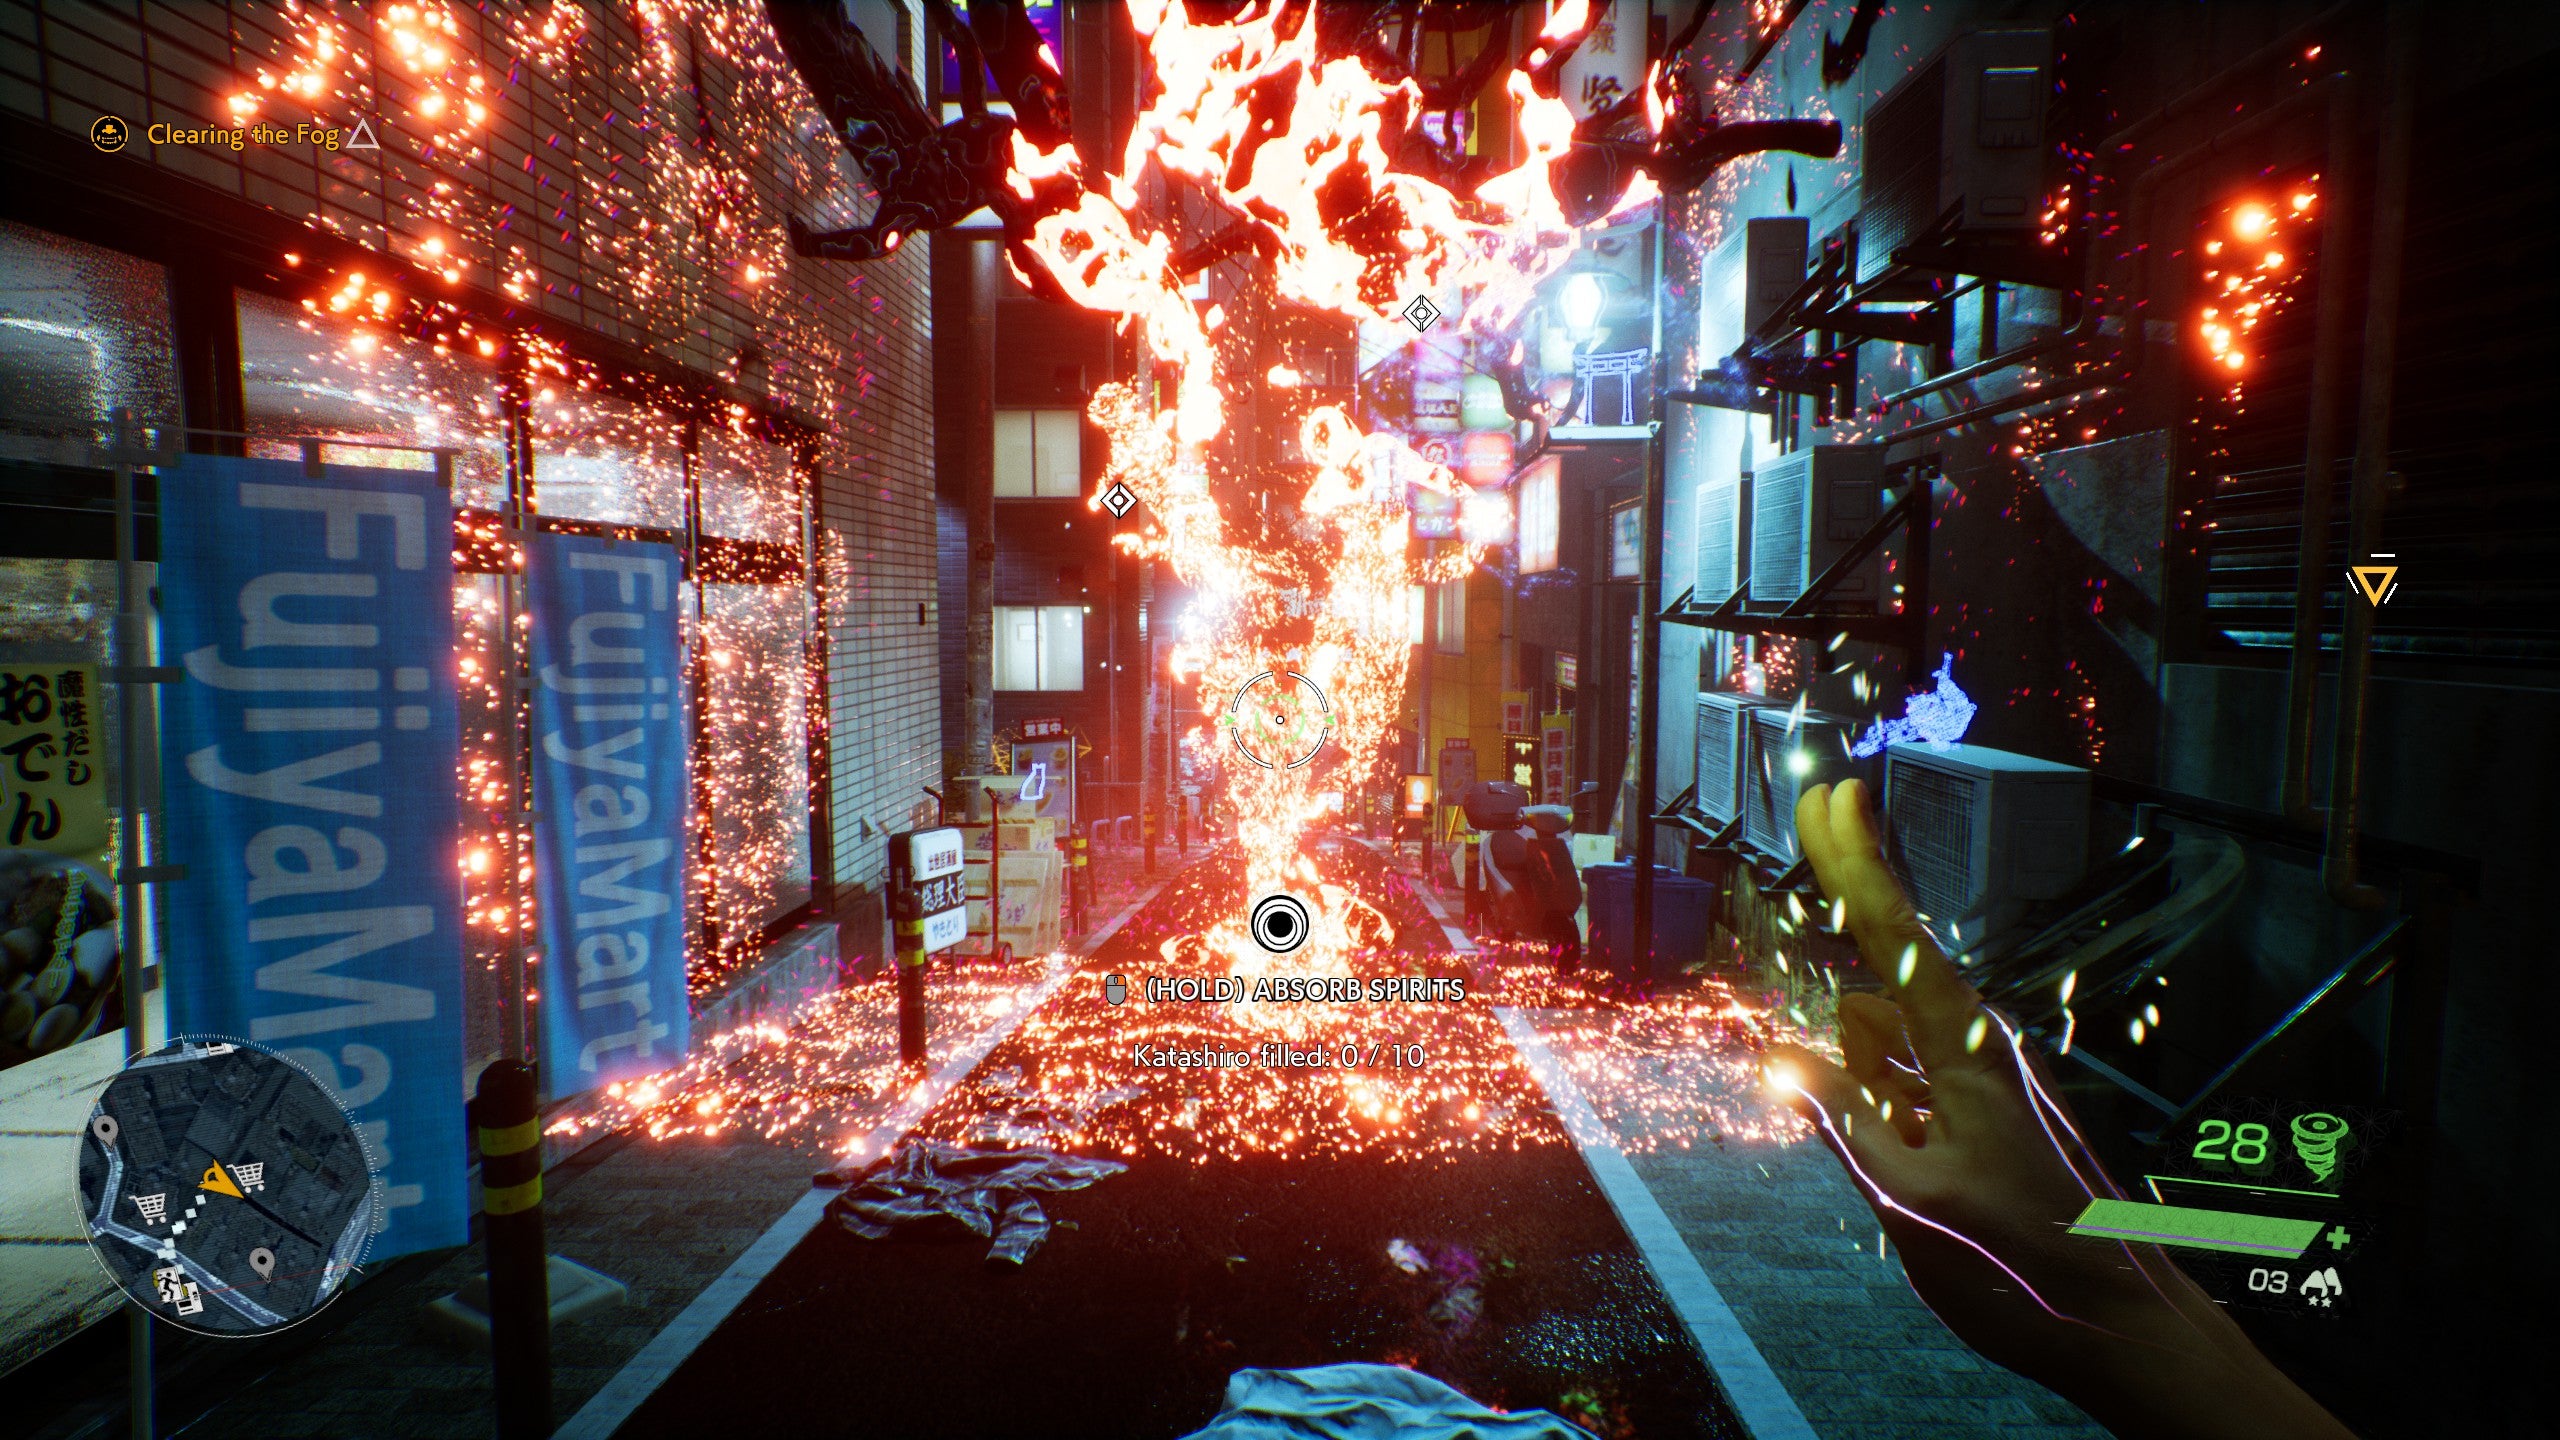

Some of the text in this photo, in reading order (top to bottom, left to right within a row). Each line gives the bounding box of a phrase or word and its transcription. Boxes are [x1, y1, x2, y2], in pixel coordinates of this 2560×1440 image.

[0, 672, 62, 846] おでん
[57, 670, 91, 786] 魔性だし
[540, 552, 672, 1072] FujiyaMart
[922, 872, 965, 912] 総理大臣
